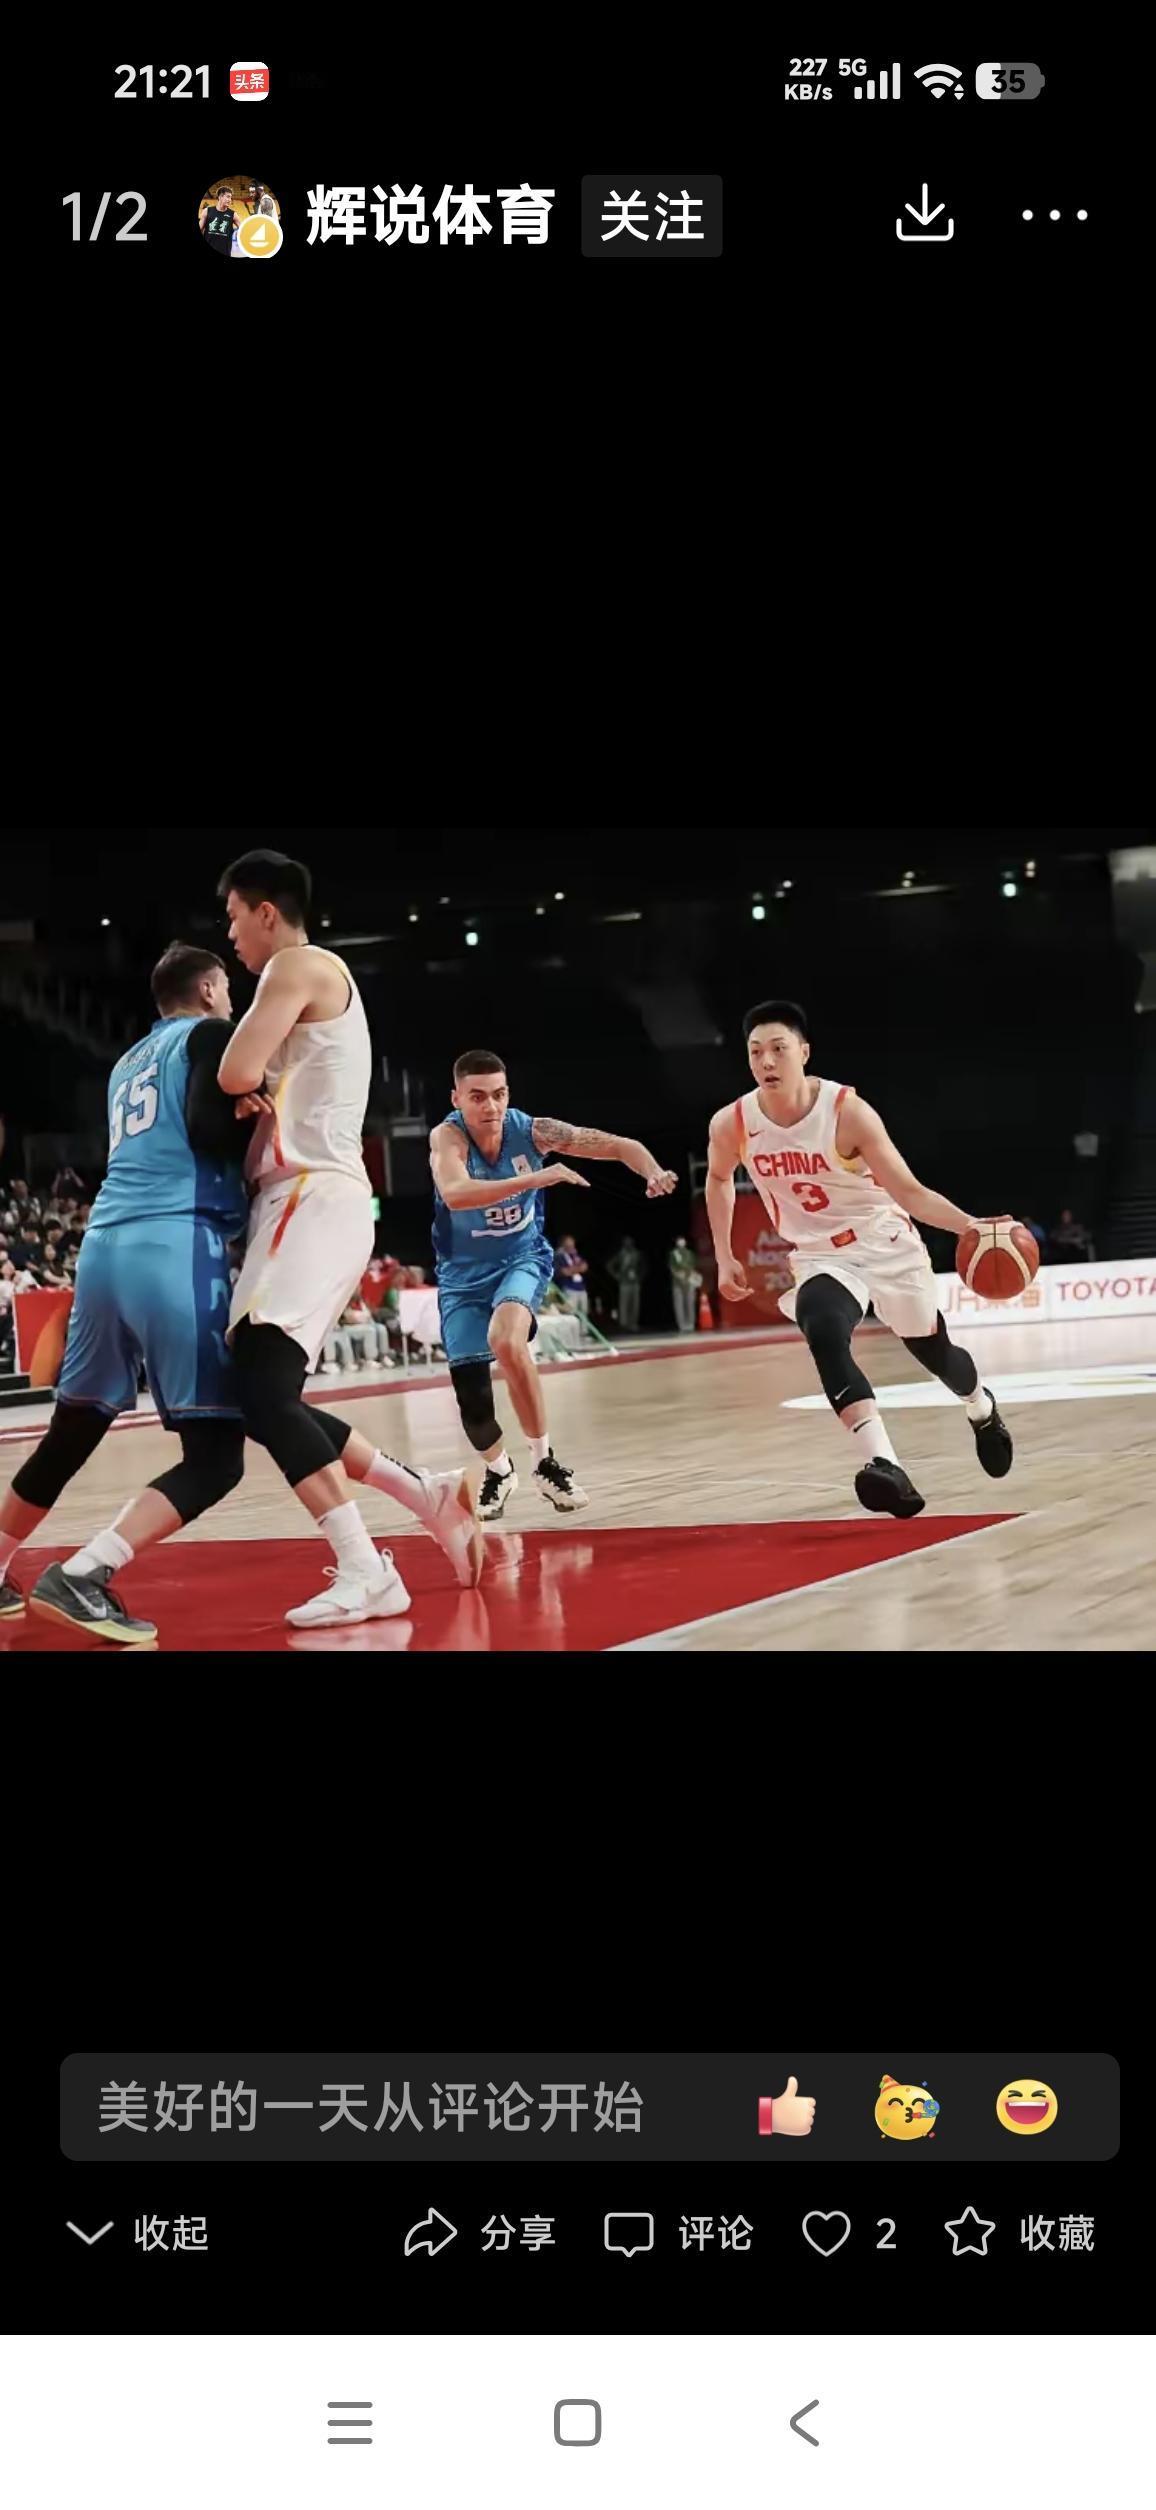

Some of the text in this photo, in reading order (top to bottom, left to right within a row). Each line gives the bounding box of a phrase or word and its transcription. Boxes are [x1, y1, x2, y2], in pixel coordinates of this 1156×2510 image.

[114, 64, 210, 99] 21:21
[235, 73, 265, 90] 头条
[789, 58, 868, 77] 227 5G
[991, 69, 1026, 94] 35
[785, 84, 833, 101] KB/s
[62, 190, 148, 242] 1/2
[306, 182, 556, 247] 辉说体育
[600, 189, 705, 242] 关注
[753, 1151, 831, 1177] CHINA
[791, 1181, 829, 1213] 3
[98, 2079, 644, 2133] 美好的一天从评论开始
[134, 2214, 209, 2252] 收起
[480, 2213, 556, 2252] 分享
[678, 2214, 754, 2252] 评论
[876, 2217, 897, 2249] 2
[1020, 2213, 1095, 2252] 收藏
